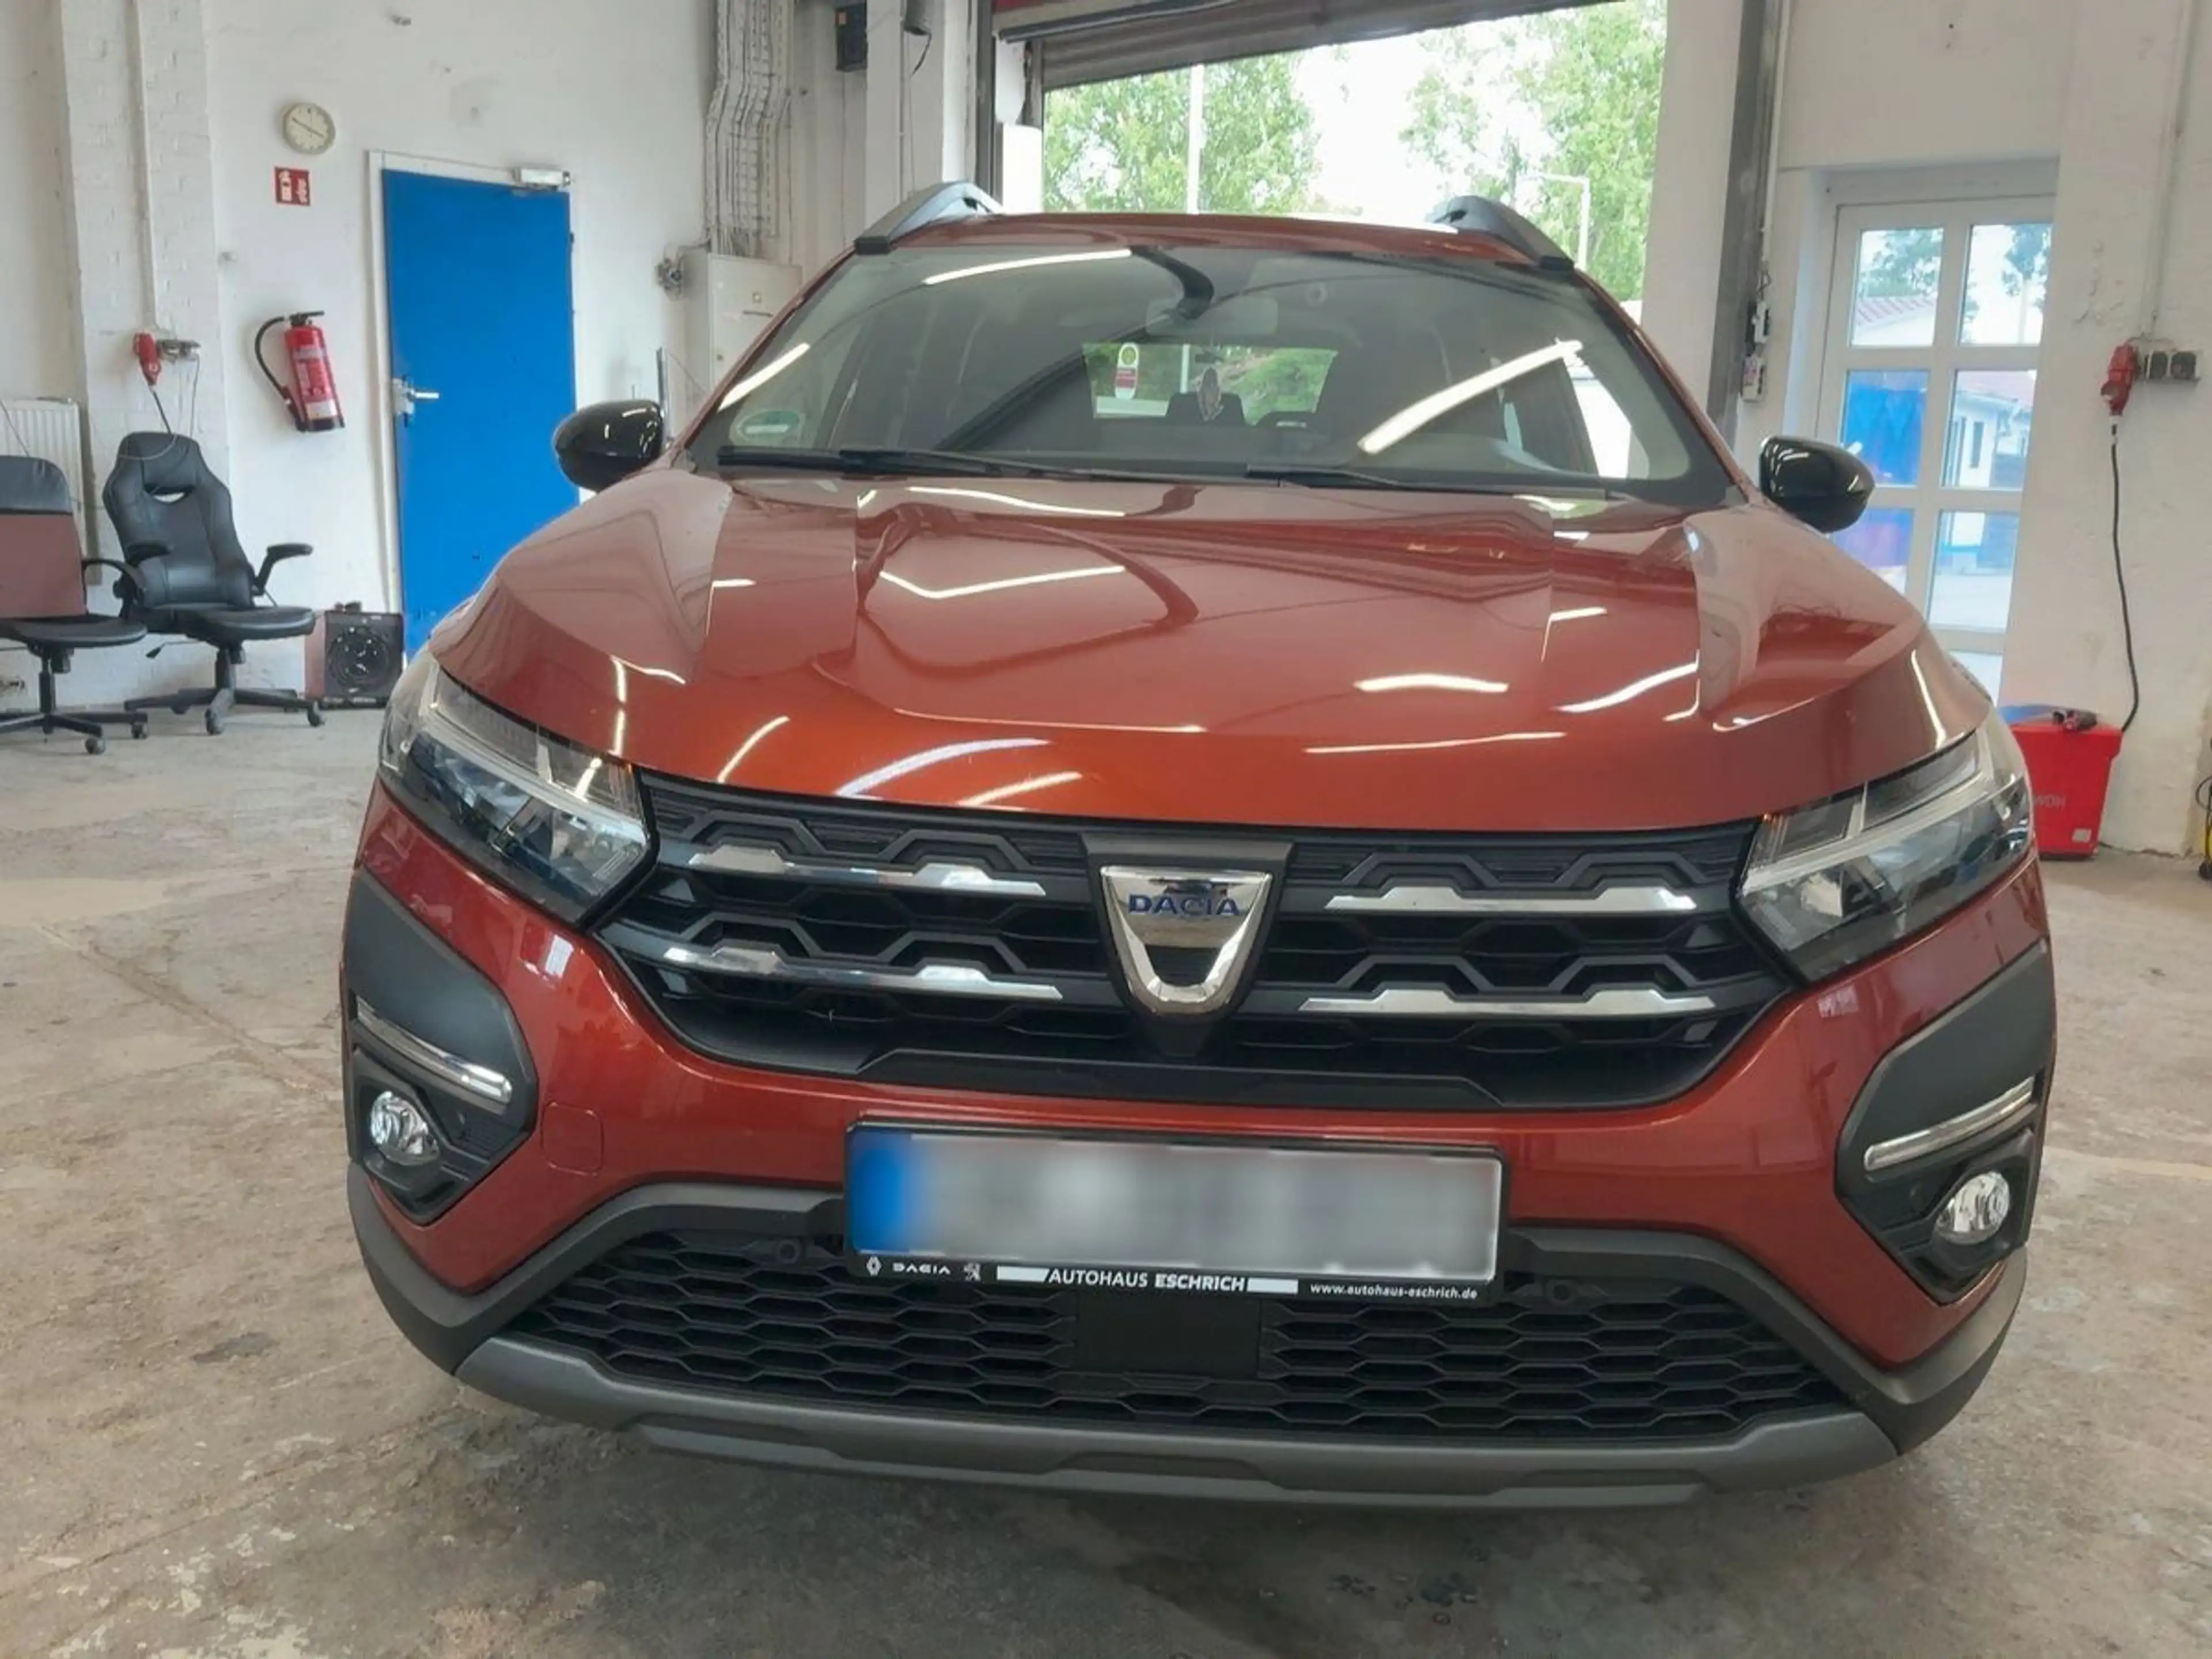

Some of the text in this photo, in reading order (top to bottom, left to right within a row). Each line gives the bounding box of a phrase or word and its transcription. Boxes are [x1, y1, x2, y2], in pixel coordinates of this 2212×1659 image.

[1129, 894, 1238, 915] DACIA
[892, 1262, 950, 1275] DACIA
[1048, 1268, 1244, 1291] AUTOHAUS ESCHRICH
[1310, 1283, 1477, 1299] www.autohaus-eschrich.de
